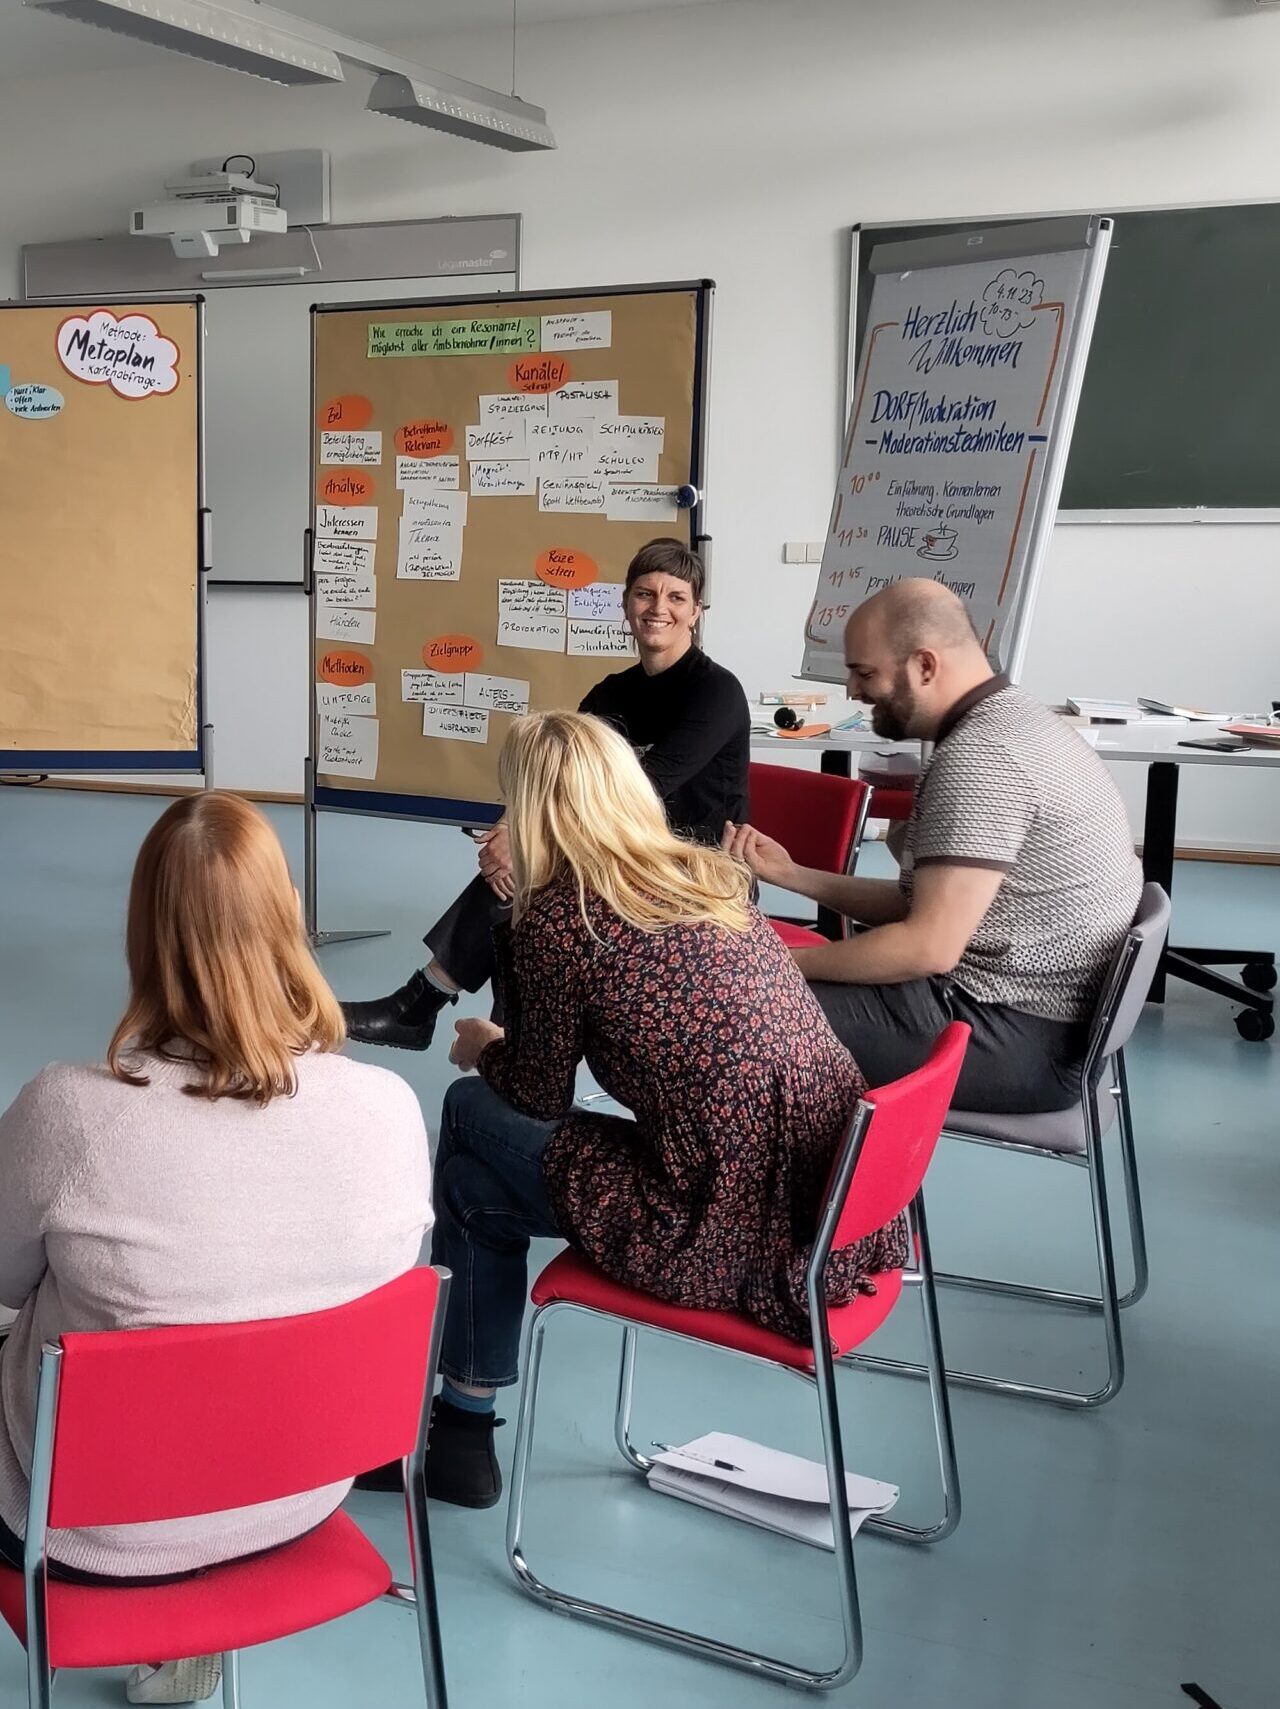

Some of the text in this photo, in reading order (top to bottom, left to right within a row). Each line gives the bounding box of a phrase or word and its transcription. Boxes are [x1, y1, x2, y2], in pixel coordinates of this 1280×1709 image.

[902, 300, 978, 341] Herzlich
[100, 322, 147, 342] Methode:
[372, 326, 386, 339] Wie
[431, 323, 442, 337] ich
[65, 328, 155, 372] Metaplan
[908, 337, 1023, 374] Willkommen
[327, 401, 343, 423] Ziel
[468, 430, 514, 448] Dorffest
[531, 424, 583, 435] ZEITUNG
[322, 433, 366, 451] Beteiligung
[405, 438, 441, 453] Relevanz
[598, 455, 645, 466] SCHULEN
[325, 477, 366, 497] Analyse
[943, 481, 1002, 498] Kennenlernen
[320, 508, 365, 528] Interessen
[945, 504, 995, 525] Grundlagen
[876, 525, 920, 549] PAUSE
[549, 549, 575, 563] Reize
[322, 656, 366, 676] Methoden
[322, 693, 371, 706] UMFRAGE
